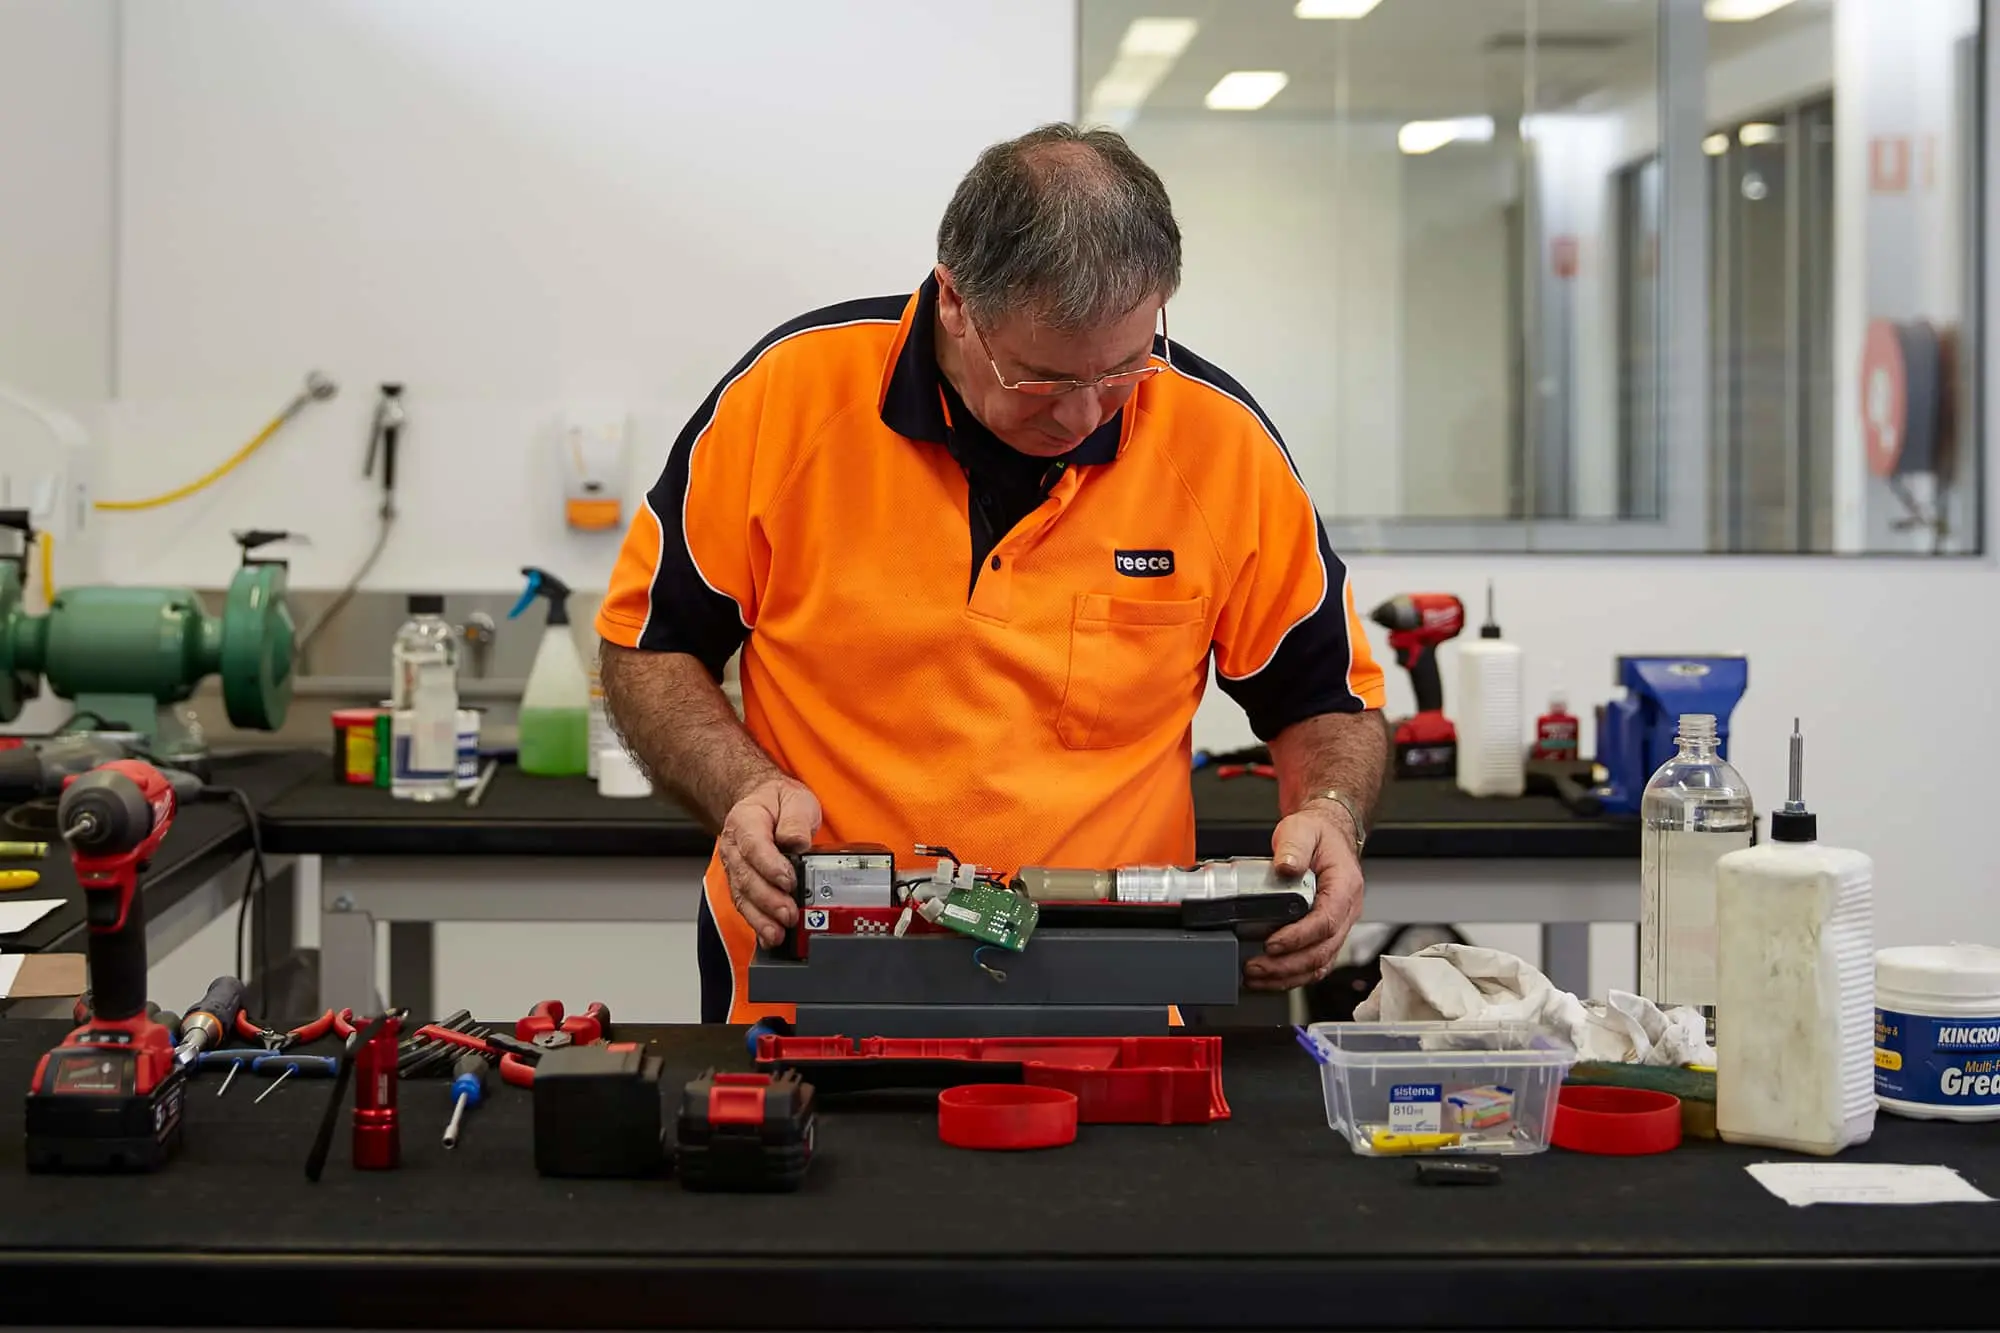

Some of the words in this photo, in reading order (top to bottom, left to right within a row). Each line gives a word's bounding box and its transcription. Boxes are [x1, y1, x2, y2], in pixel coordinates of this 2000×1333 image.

[1116, 555, 1169, 570] reece
[1938, 1027, 2000, 1043] KINCRO
[1941, 1067, 2000, 1095] Grea
[1394, 1086, 1435, 1096] sistema
